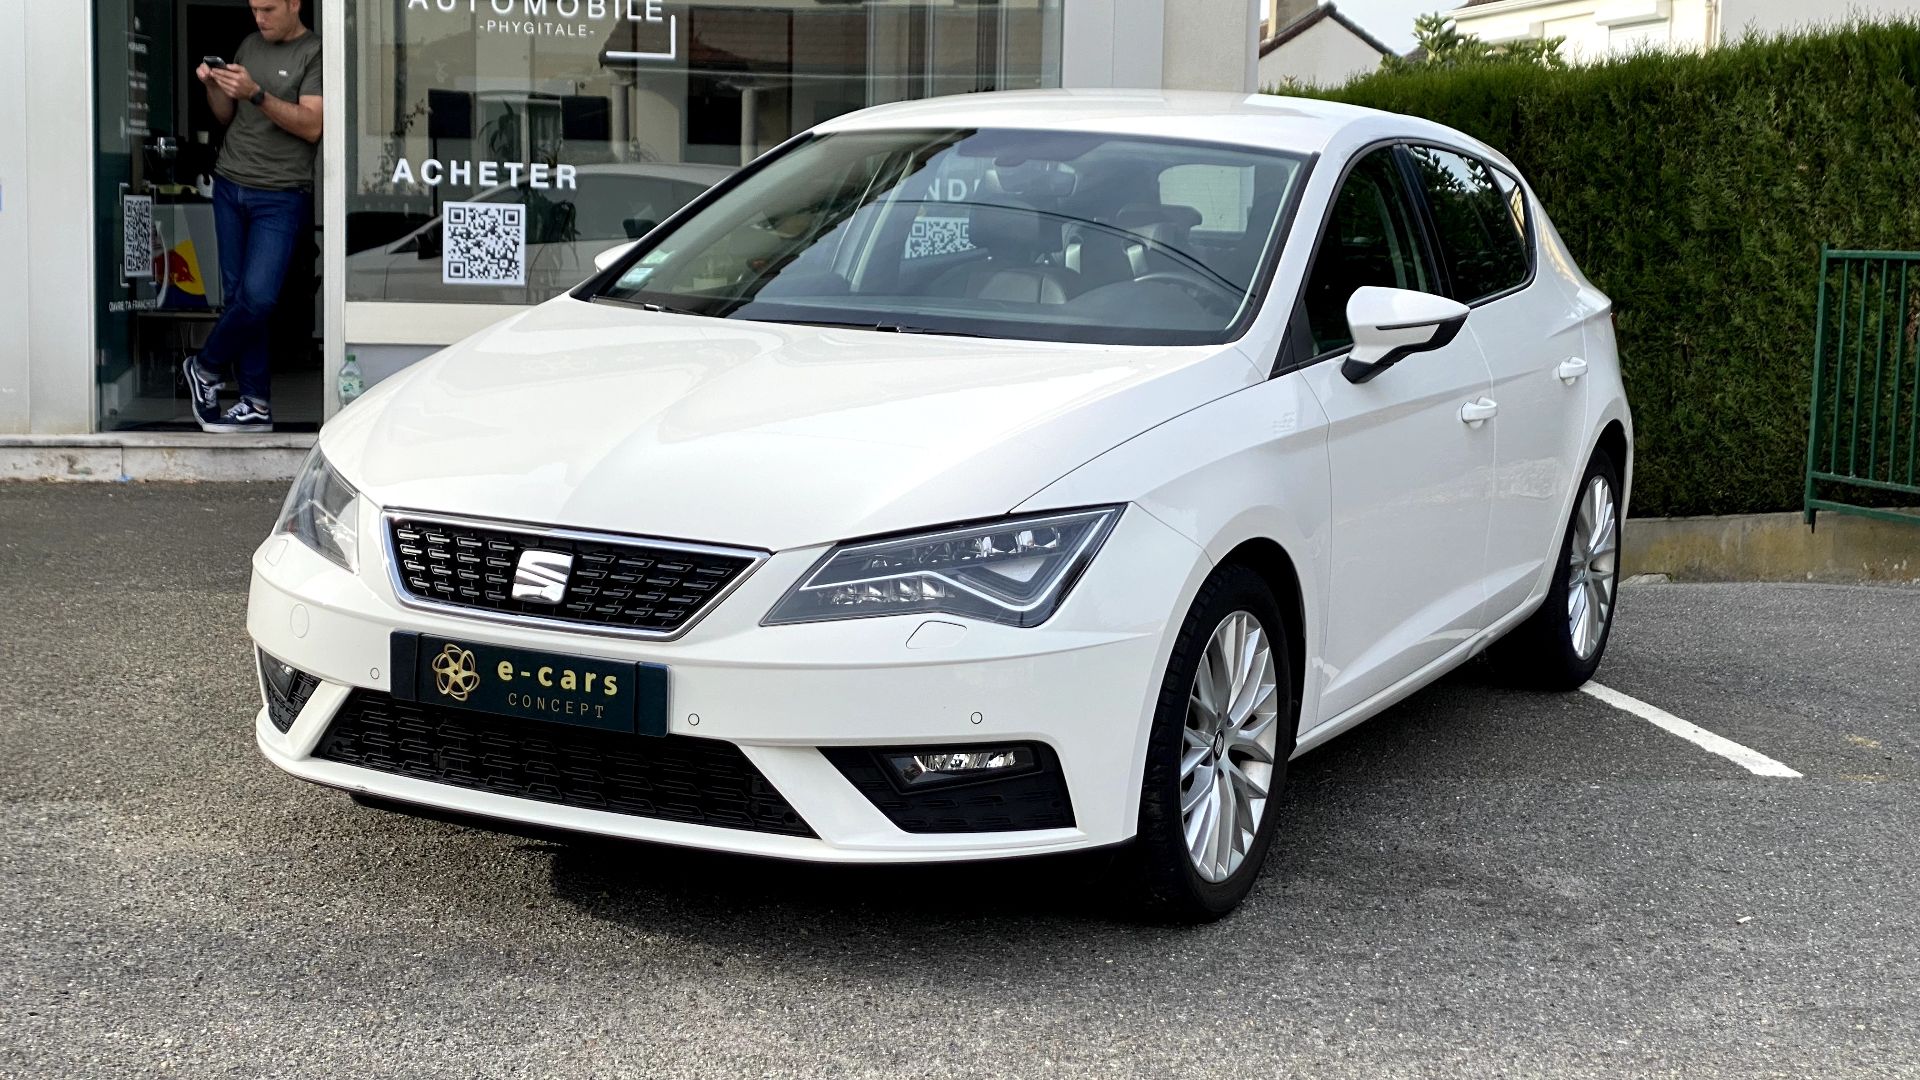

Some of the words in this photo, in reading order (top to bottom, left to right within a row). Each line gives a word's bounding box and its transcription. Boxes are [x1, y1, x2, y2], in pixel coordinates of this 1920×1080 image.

[391, 157, 578, 190] ACHETER
[497, 660, 618, 696] e-cars
[508, 692, 604, 719] CONCEPT
